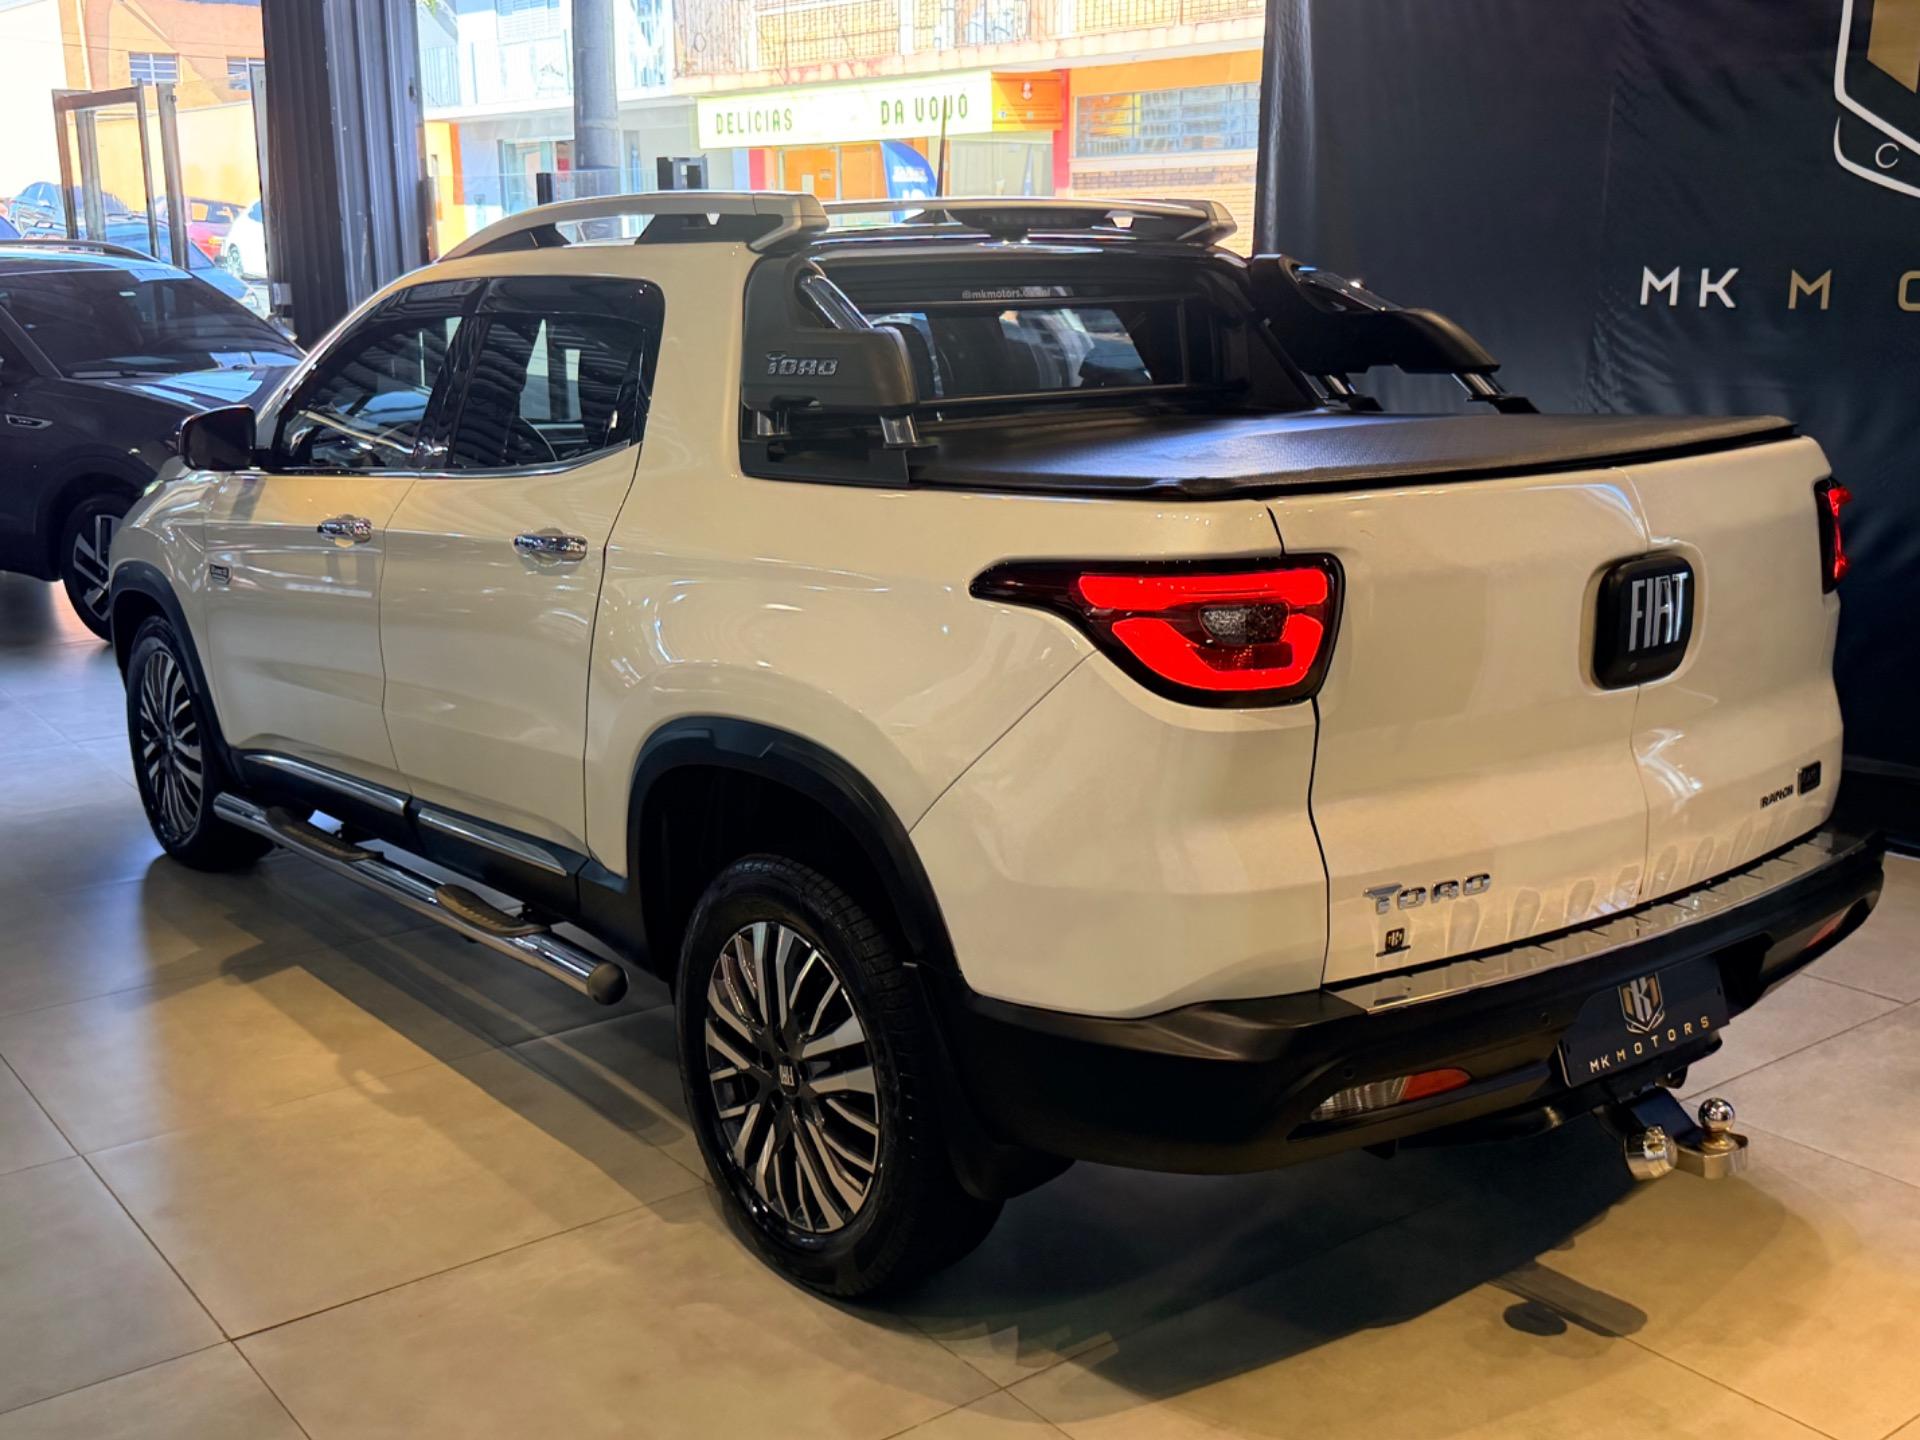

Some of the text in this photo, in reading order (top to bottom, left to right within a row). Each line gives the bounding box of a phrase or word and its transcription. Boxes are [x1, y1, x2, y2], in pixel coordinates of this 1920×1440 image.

[881, 99, 903, 124] DA
[1639, 265, 1739, 308] MK
[1628, 571, 1689, 652] FIAT
[1362, 873, 1490, 915] TORO
[1589, 1015, 1711, 1074] MK MOTORS
